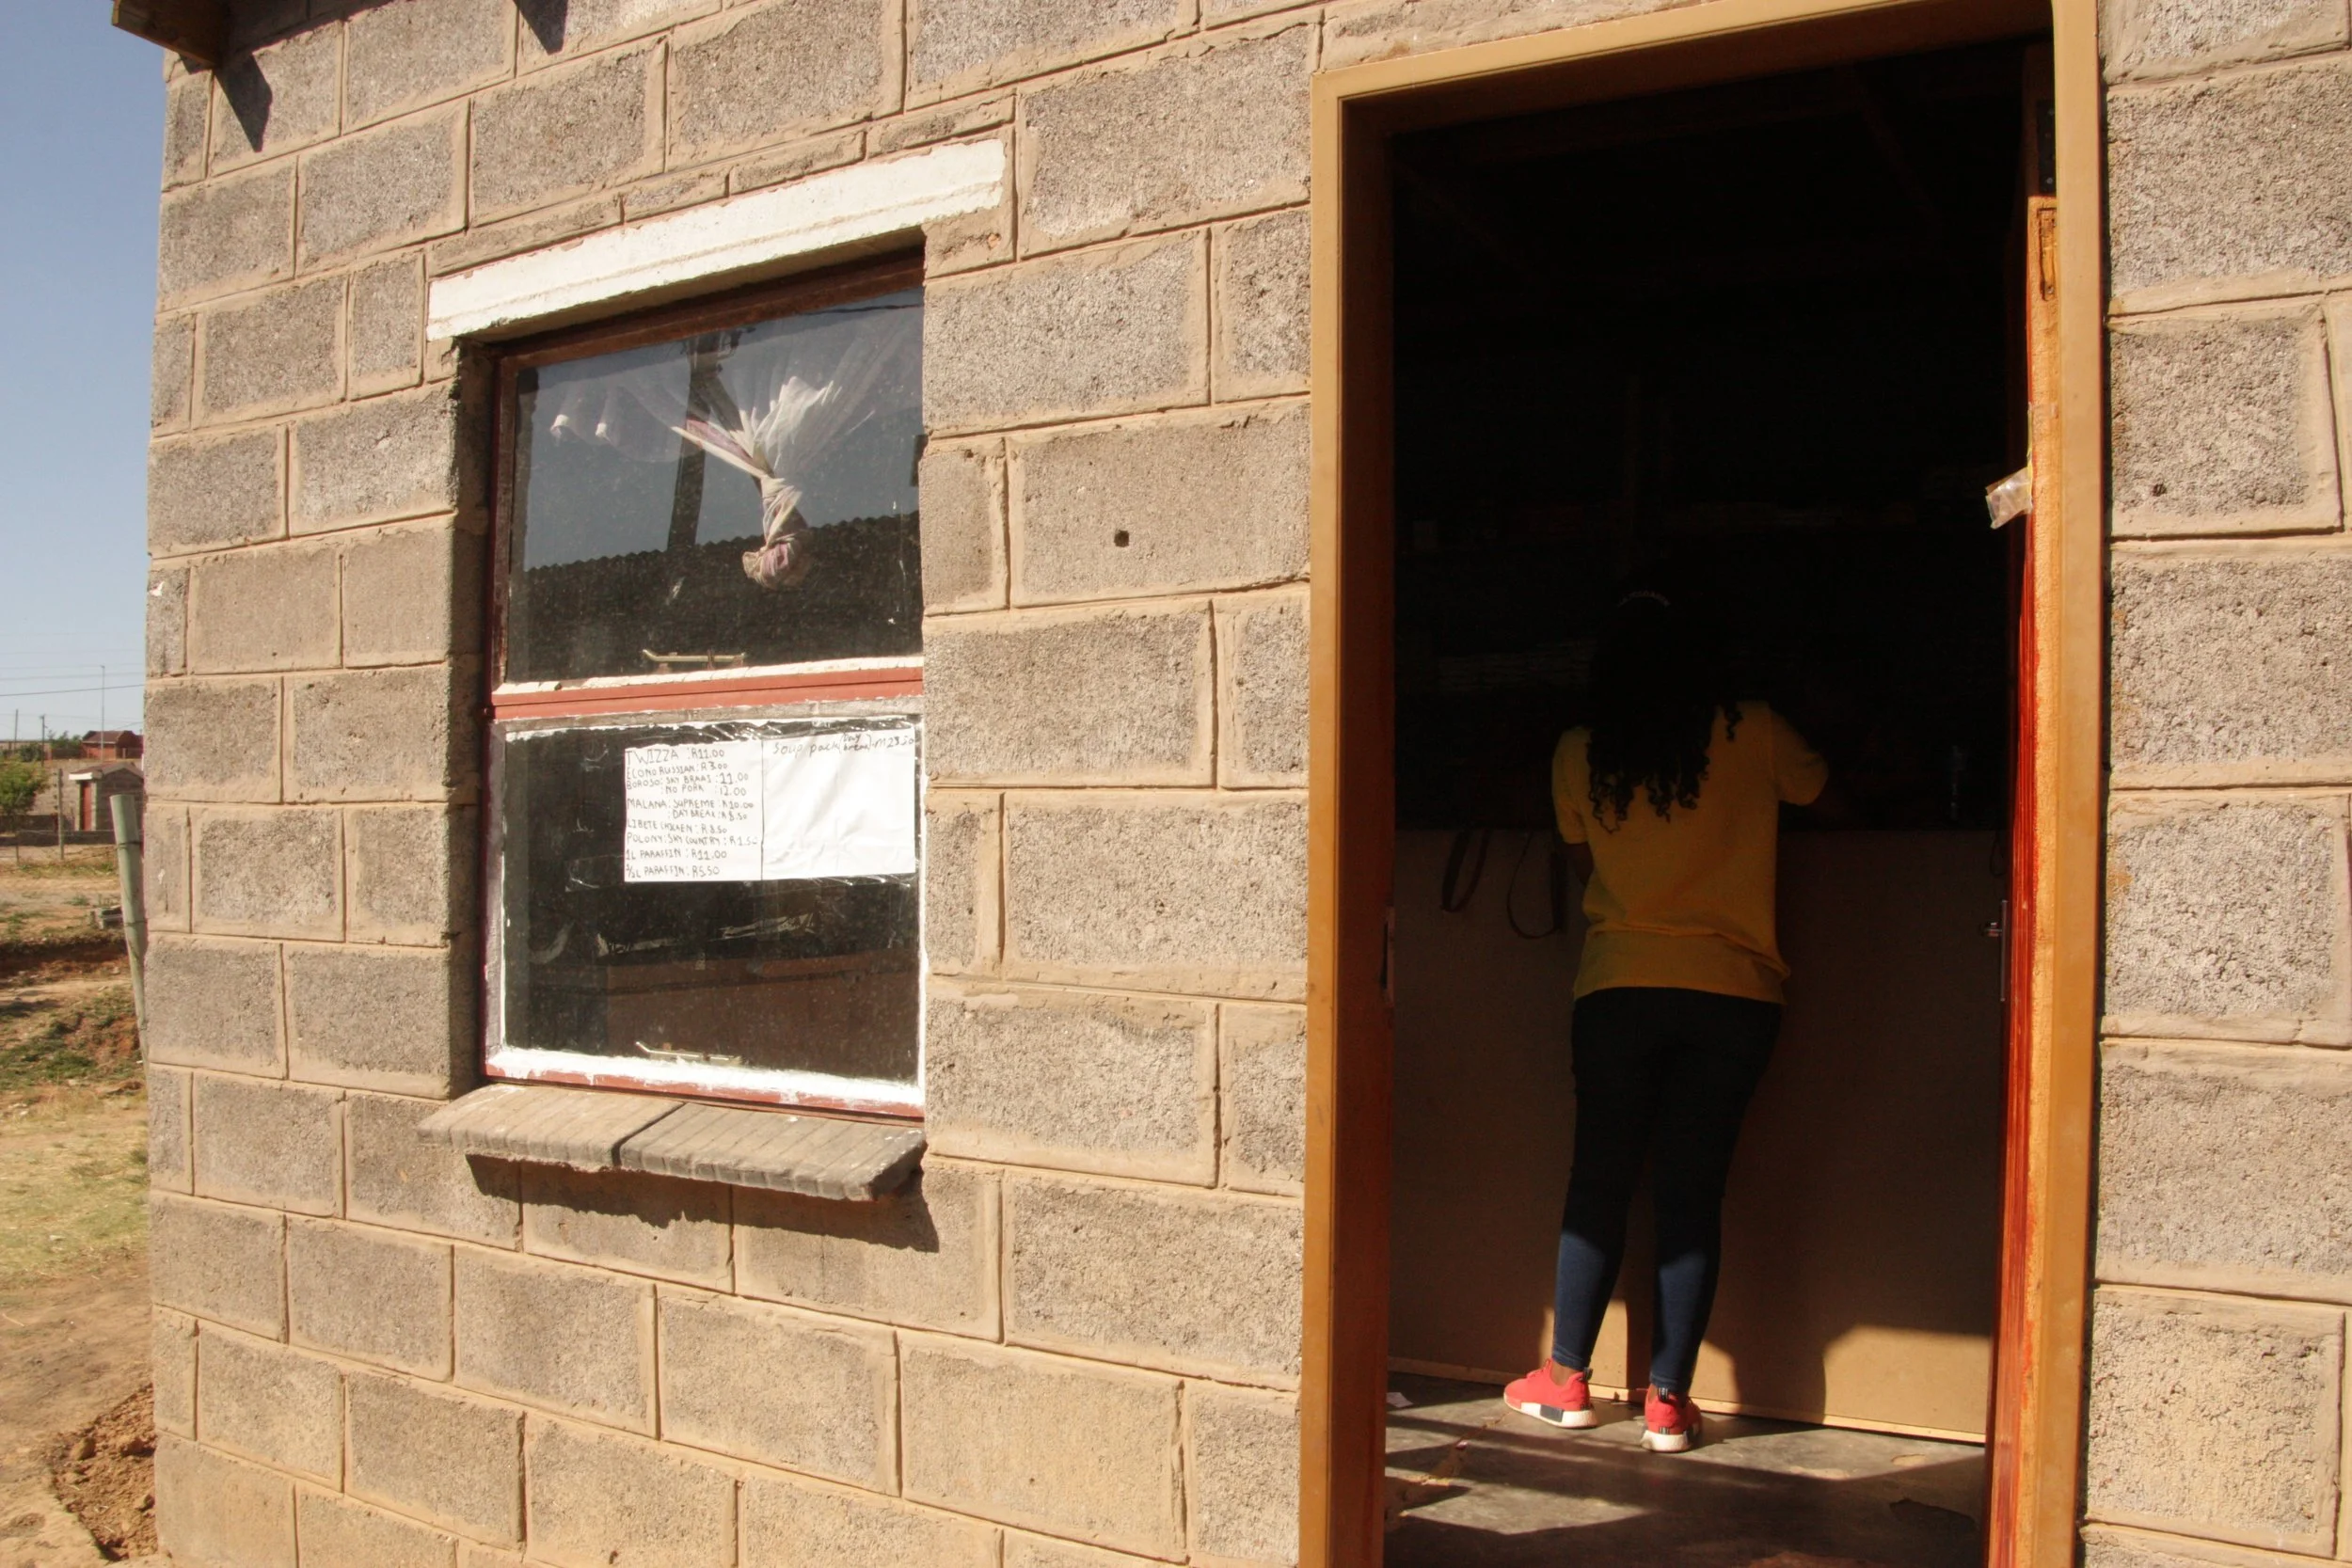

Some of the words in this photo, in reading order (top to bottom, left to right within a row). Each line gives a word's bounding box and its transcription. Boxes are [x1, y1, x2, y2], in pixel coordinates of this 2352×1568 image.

[626, 749, 678, 765] TWIZZA
[627, 768, 657, 780] ECONO
[627, 818, 658, 829] LIBETE
